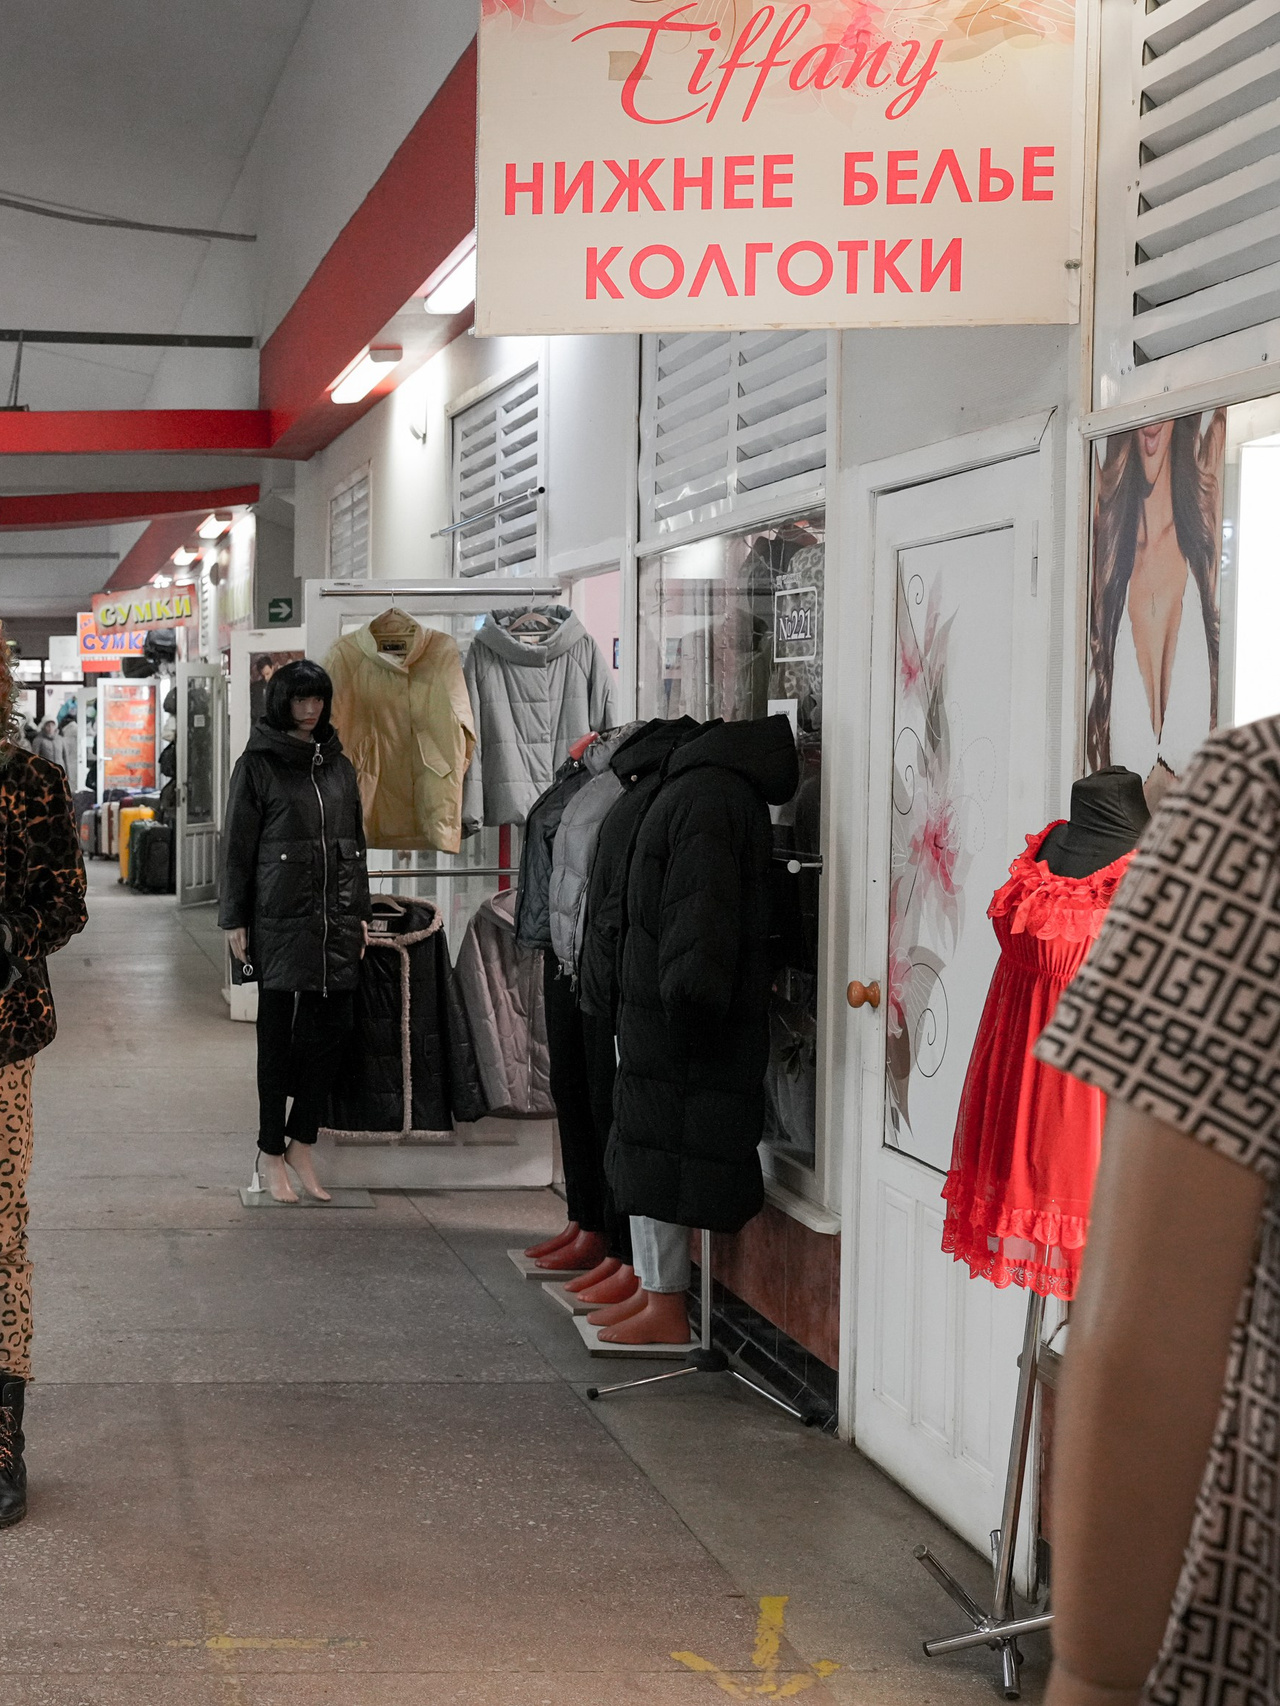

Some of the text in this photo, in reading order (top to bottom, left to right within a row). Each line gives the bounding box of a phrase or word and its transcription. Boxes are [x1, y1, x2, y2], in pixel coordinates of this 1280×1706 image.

[571, 2, 944, 125] Tiffany
[505, 146, 1056, 215] НИЖНЕЕ БЕЛЬЕ
[585, 237, 963, 300] КОЛГОТКИ
[83, 633, 147, 650] СУМК
[99, 595, 193, 628] СУМКИ
